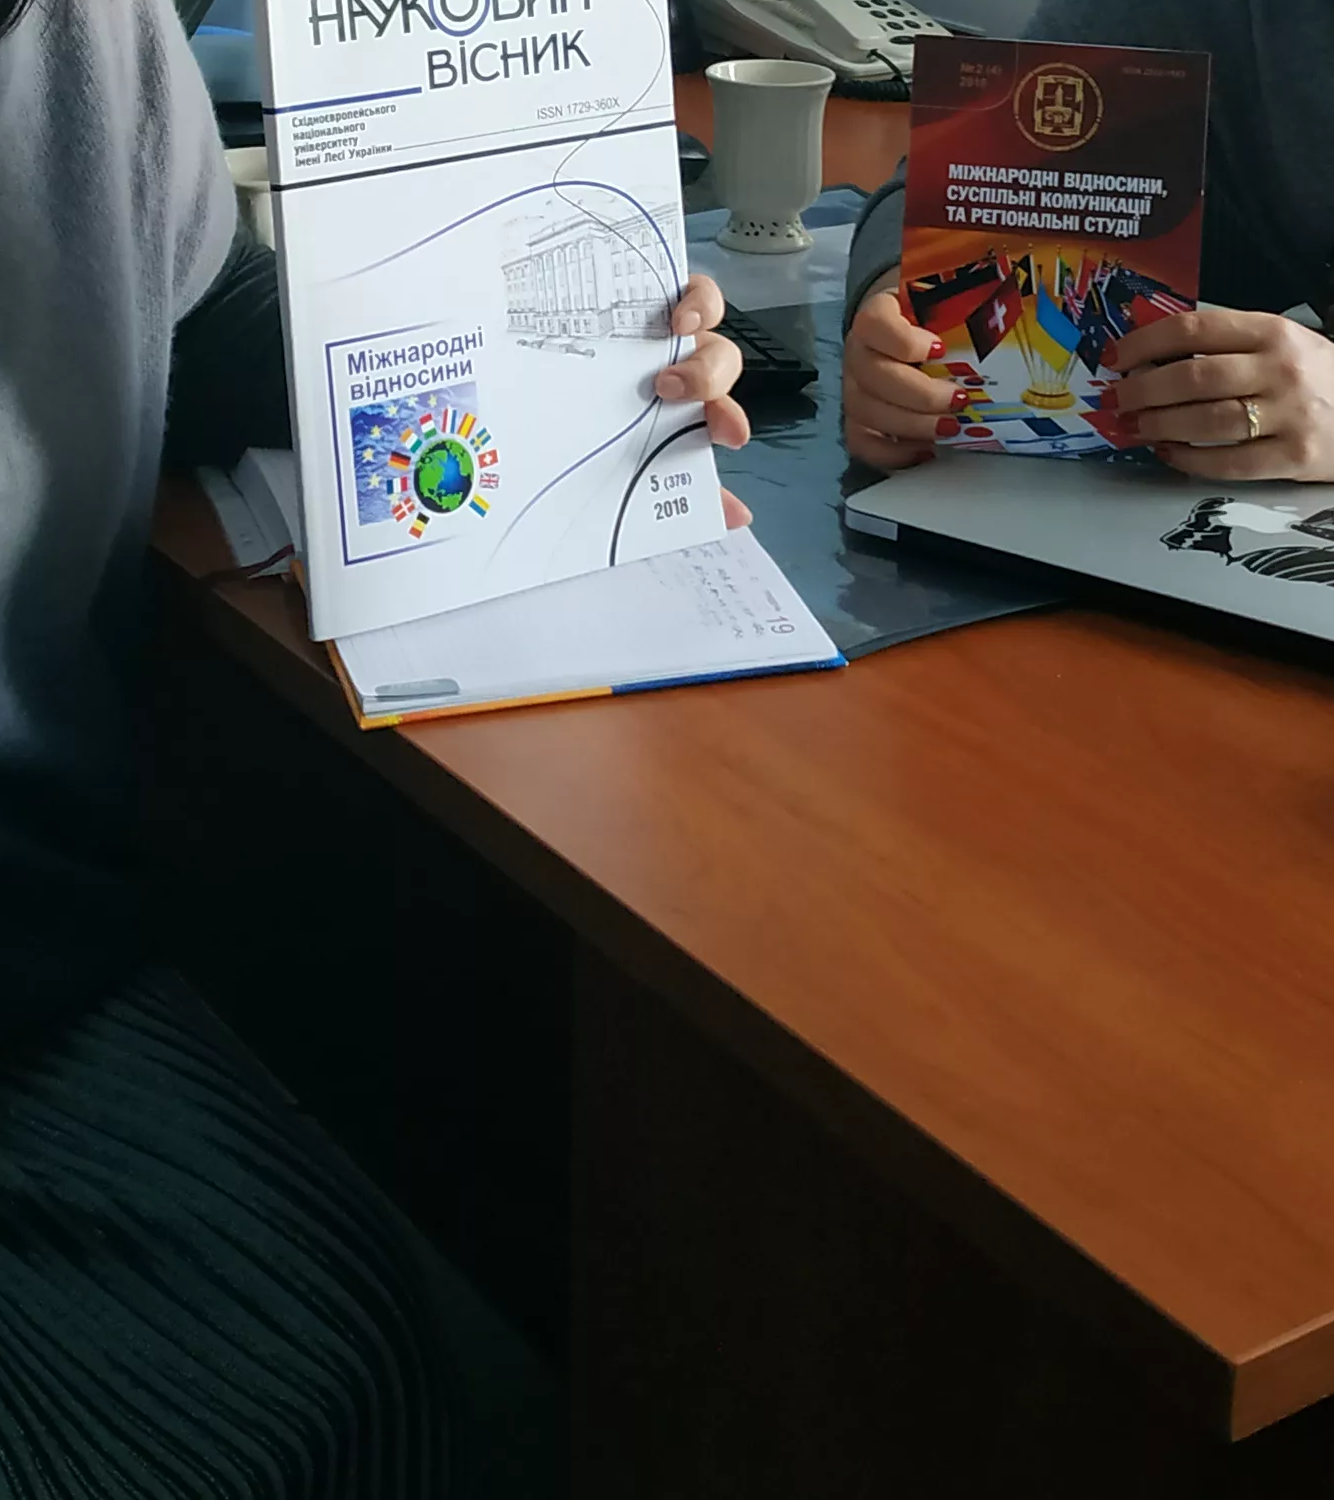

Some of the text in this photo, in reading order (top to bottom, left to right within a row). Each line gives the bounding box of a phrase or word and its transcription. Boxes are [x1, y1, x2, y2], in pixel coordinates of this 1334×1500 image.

[291, 104, 397, 128] Східноєвропейського
[537, 96, 620, 120] ISSN 1729-360X
[292, 122, 366, 141] національного
[294, 136, 359, 156] університету
[295, 144, 393, 167] імені Лесі Українки
[948, 163, 1168, 199] МІЖНАРОДНІ ВІДНОСИНИ,
[946, 185, 1152, 216] СУСПІЛЬНІ КОМУНІКАЦІЇ
[945, 205, 1141, 238] ТА РЕГІОНАЛЬНІ СТУДІЇ
[347, 325, 484, 376] Міжнародні
[350, 358, 473, 401] відносини
[650, 471, 693, 493] 5 (378)
[653, 496, 689, 521] 2018
[766, 614, 796, 636] 19
